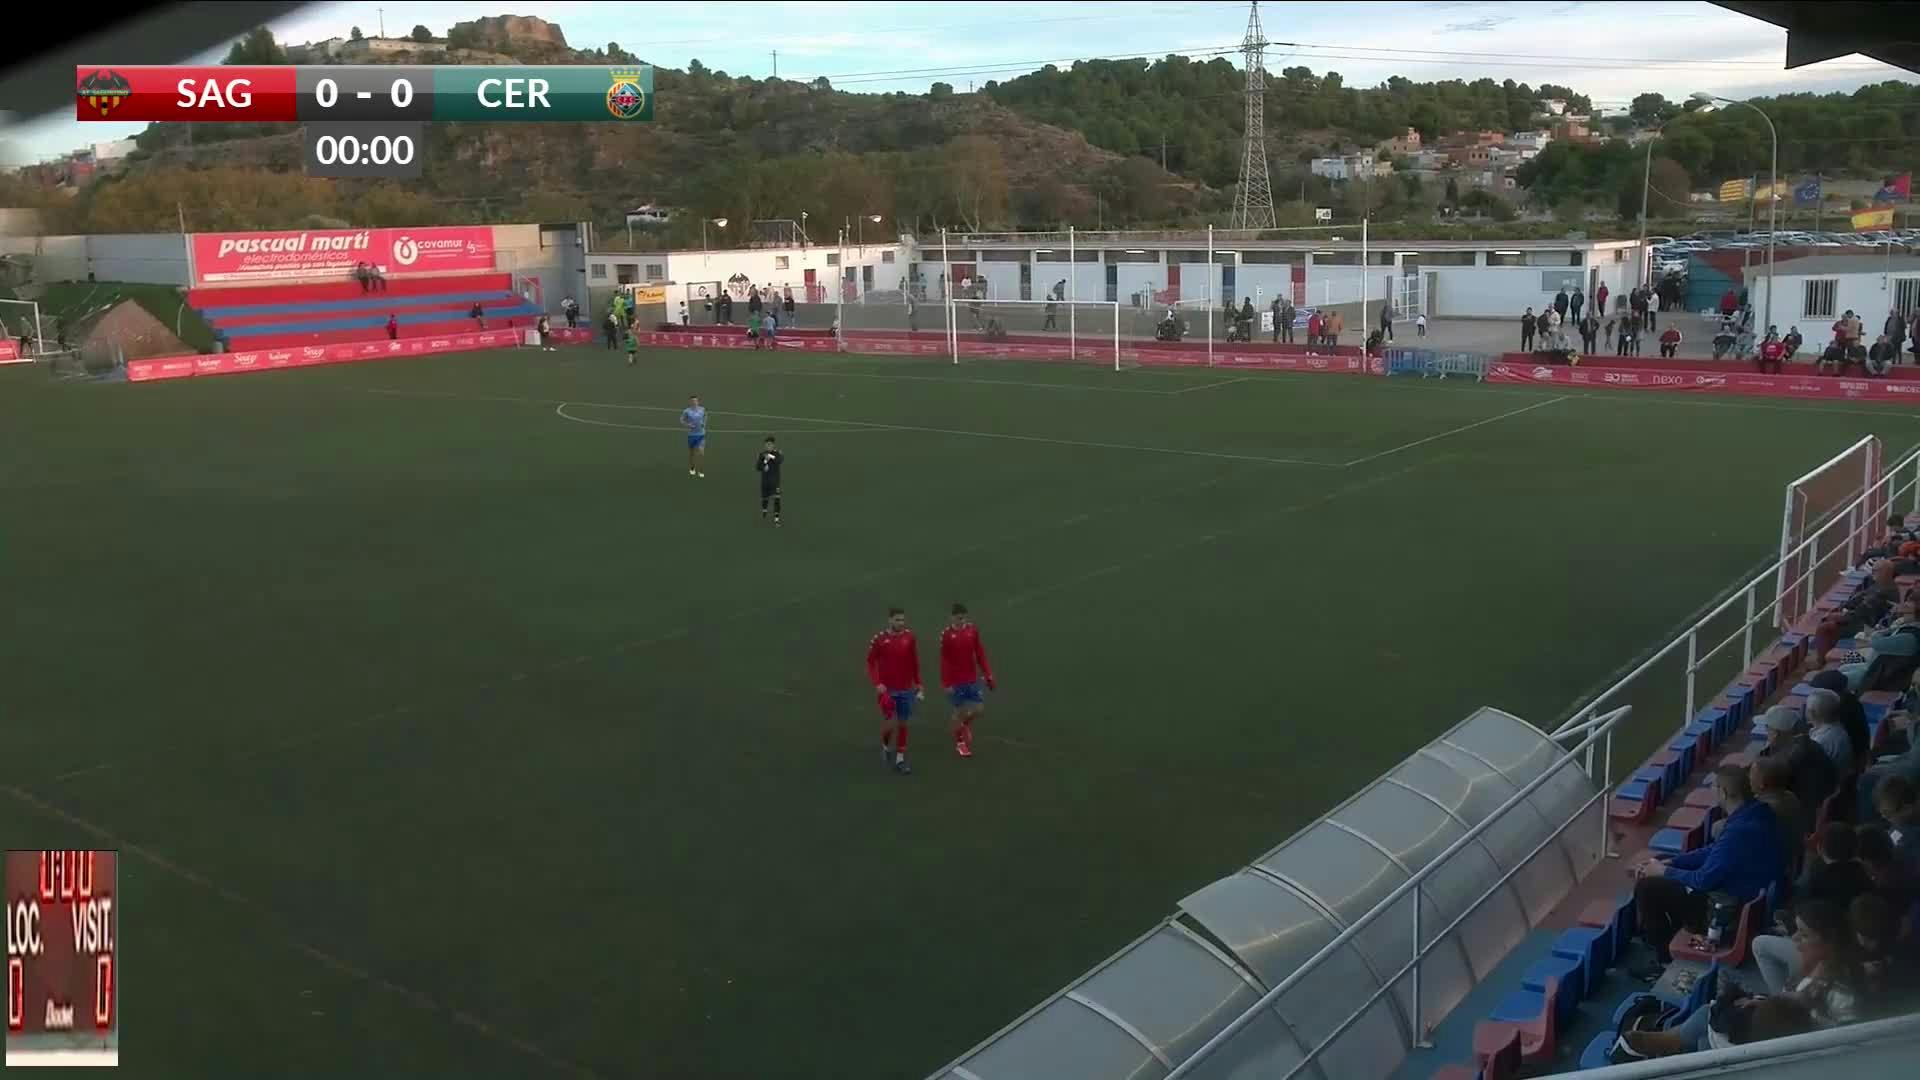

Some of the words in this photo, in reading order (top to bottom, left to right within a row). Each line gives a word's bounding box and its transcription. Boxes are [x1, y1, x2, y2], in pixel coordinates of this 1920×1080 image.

[218, 233, 308, 258] pascual
[310, 231, 370, 250] martí
[417, 239, 462, 249] covamur
[243, 250, 349, 264] electrodomésticos
[1652, 375, 1683, 385] nexo
[6, 901, 45, 953] LOC.
[72, 900, 113, 952] VISIT.
